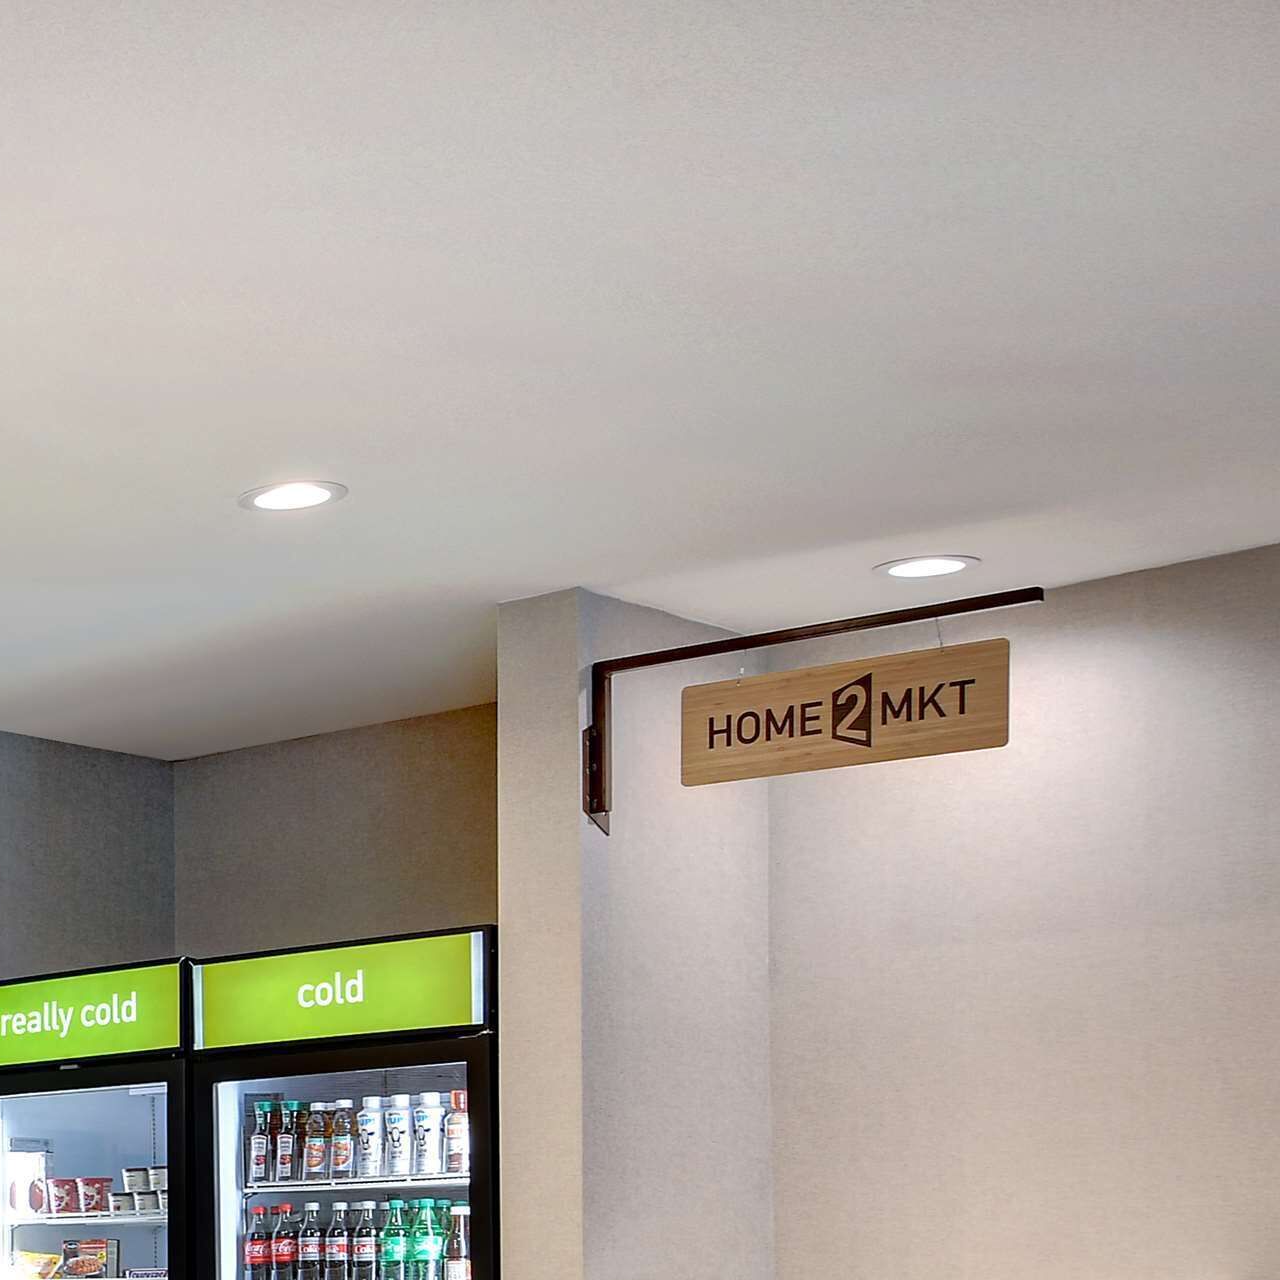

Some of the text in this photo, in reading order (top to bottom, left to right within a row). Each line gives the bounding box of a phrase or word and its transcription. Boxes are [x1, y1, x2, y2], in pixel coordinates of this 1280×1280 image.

[297, 969, 364, 1008] cold
[0, 991, 137, 1038] really cold
